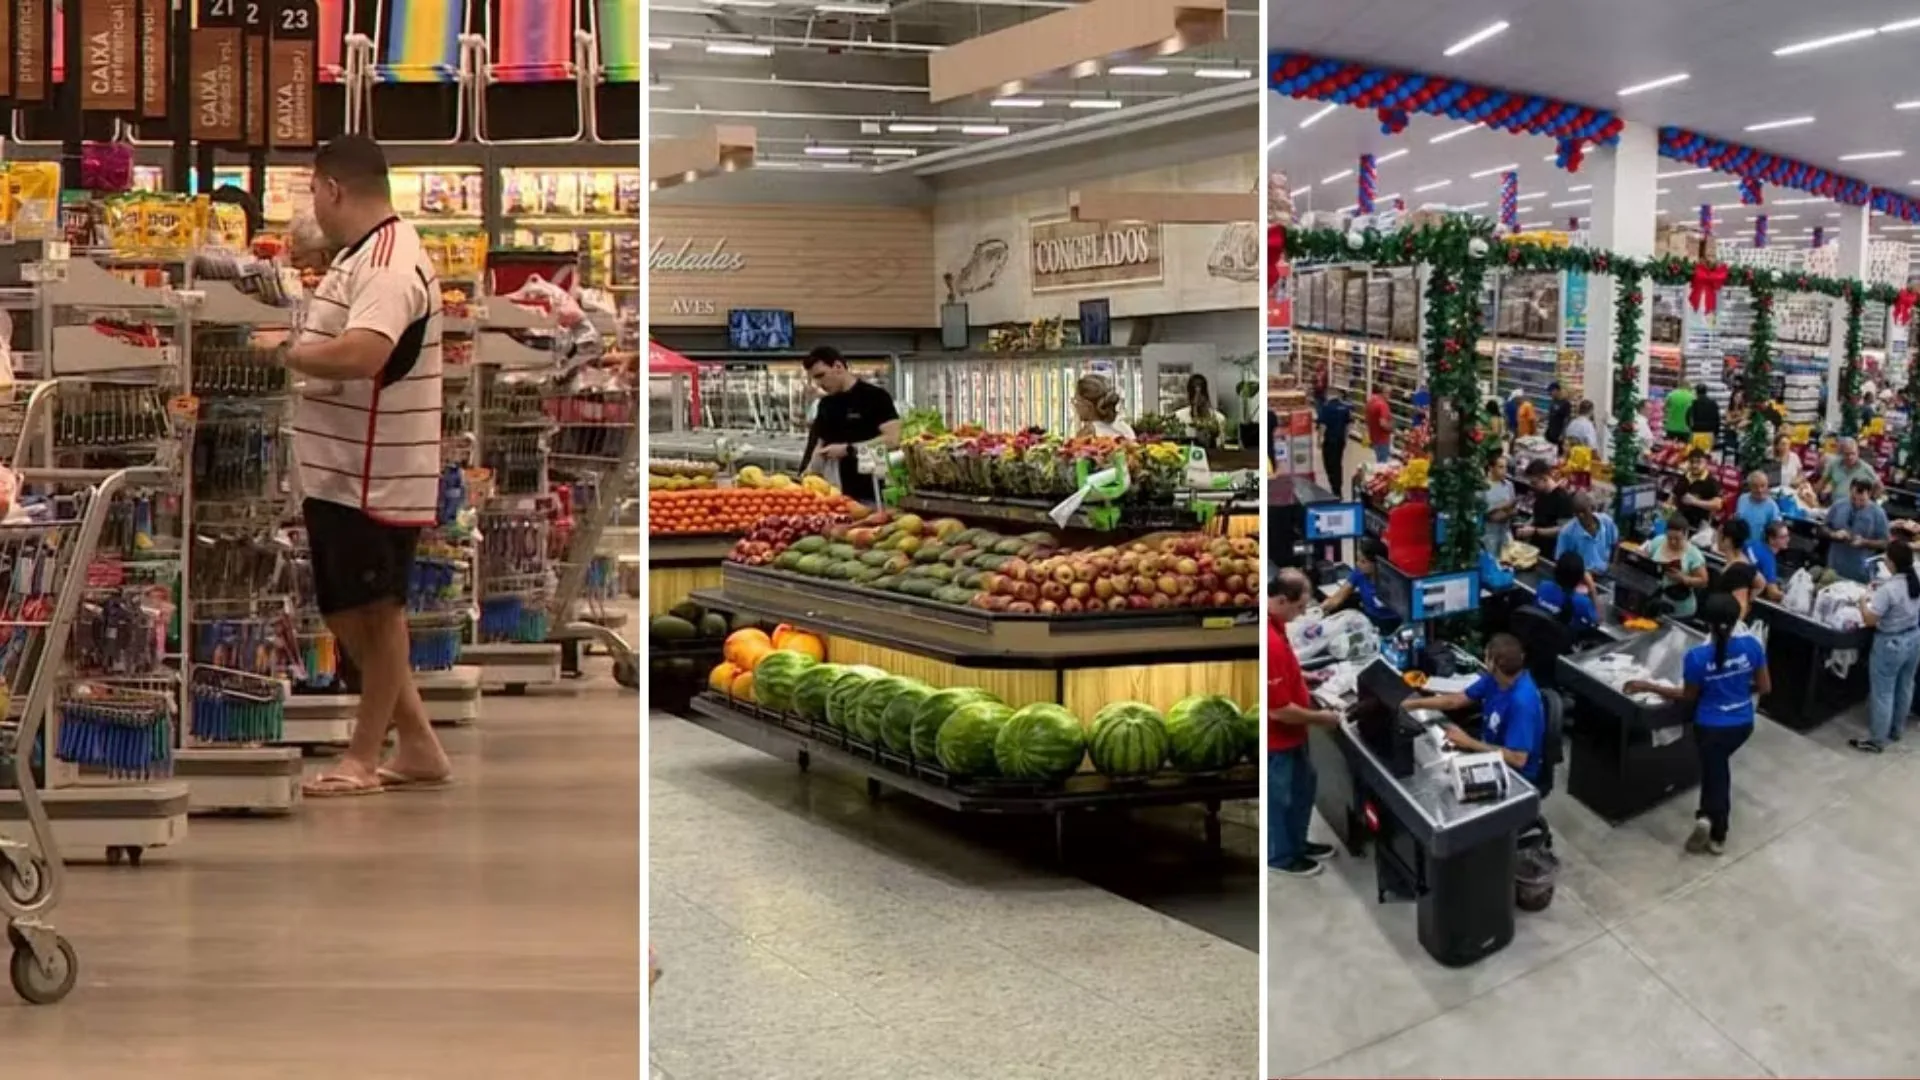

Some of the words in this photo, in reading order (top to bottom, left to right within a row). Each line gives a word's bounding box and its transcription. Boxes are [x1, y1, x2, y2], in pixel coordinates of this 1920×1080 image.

[281, 9, 309, 30] 23
[90, 30, 110, 95] CAIXA
[110, 3, 127, 95] preferencial
[218, 63, 232, 81] 20
[201, 69, 218, 128] CAIXA
[276, 83, 294, 140] CAIXA
[1036, 226, 1149, 273] CONGELADOS
[670, 299, 715, 316] AVES
